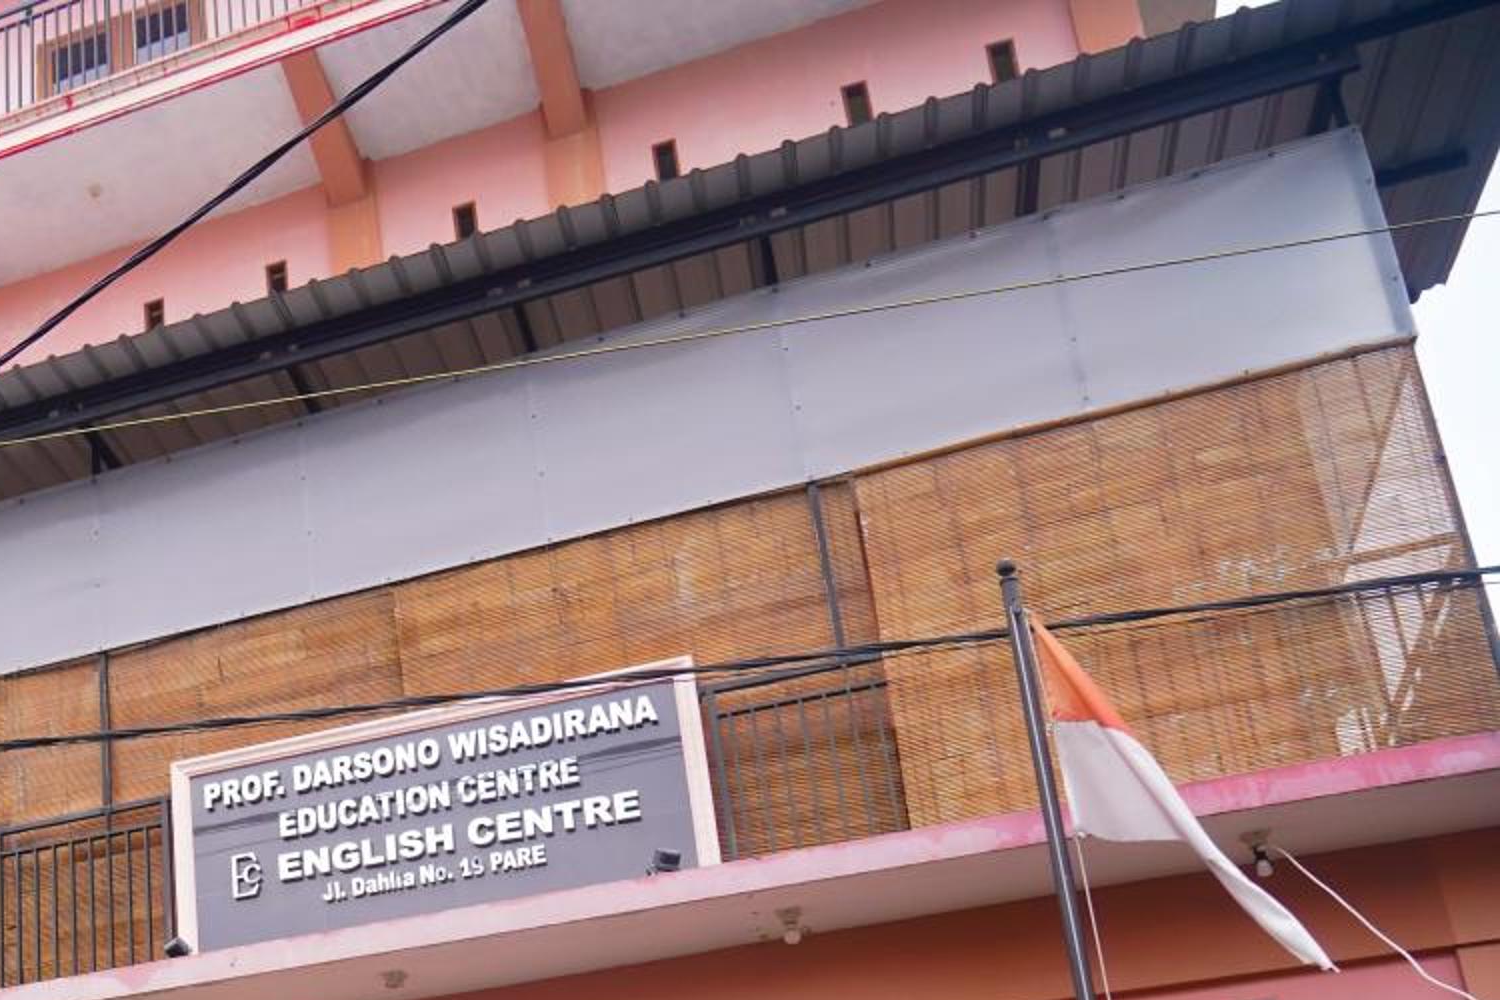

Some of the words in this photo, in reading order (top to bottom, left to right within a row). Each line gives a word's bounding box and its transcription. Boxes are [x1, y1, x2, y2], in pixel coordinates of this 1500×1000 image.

[202, 771, 285, 811] PROF.
[292, 737, 440, 796] DARSONO
[449, 694, 660, 759] WISADIRANA
[277, 822, 456, 882] ENGLISH
[465, 788, 643, 848] CENTRE
[278, 778, 452, 840] EDUCATION
[456, 755, 582, 808] CENTRE
[351, 867, 416, 899] Dahlia
[419, 864, 455, 890] No.
[490, 843, 548, 874] PARE
